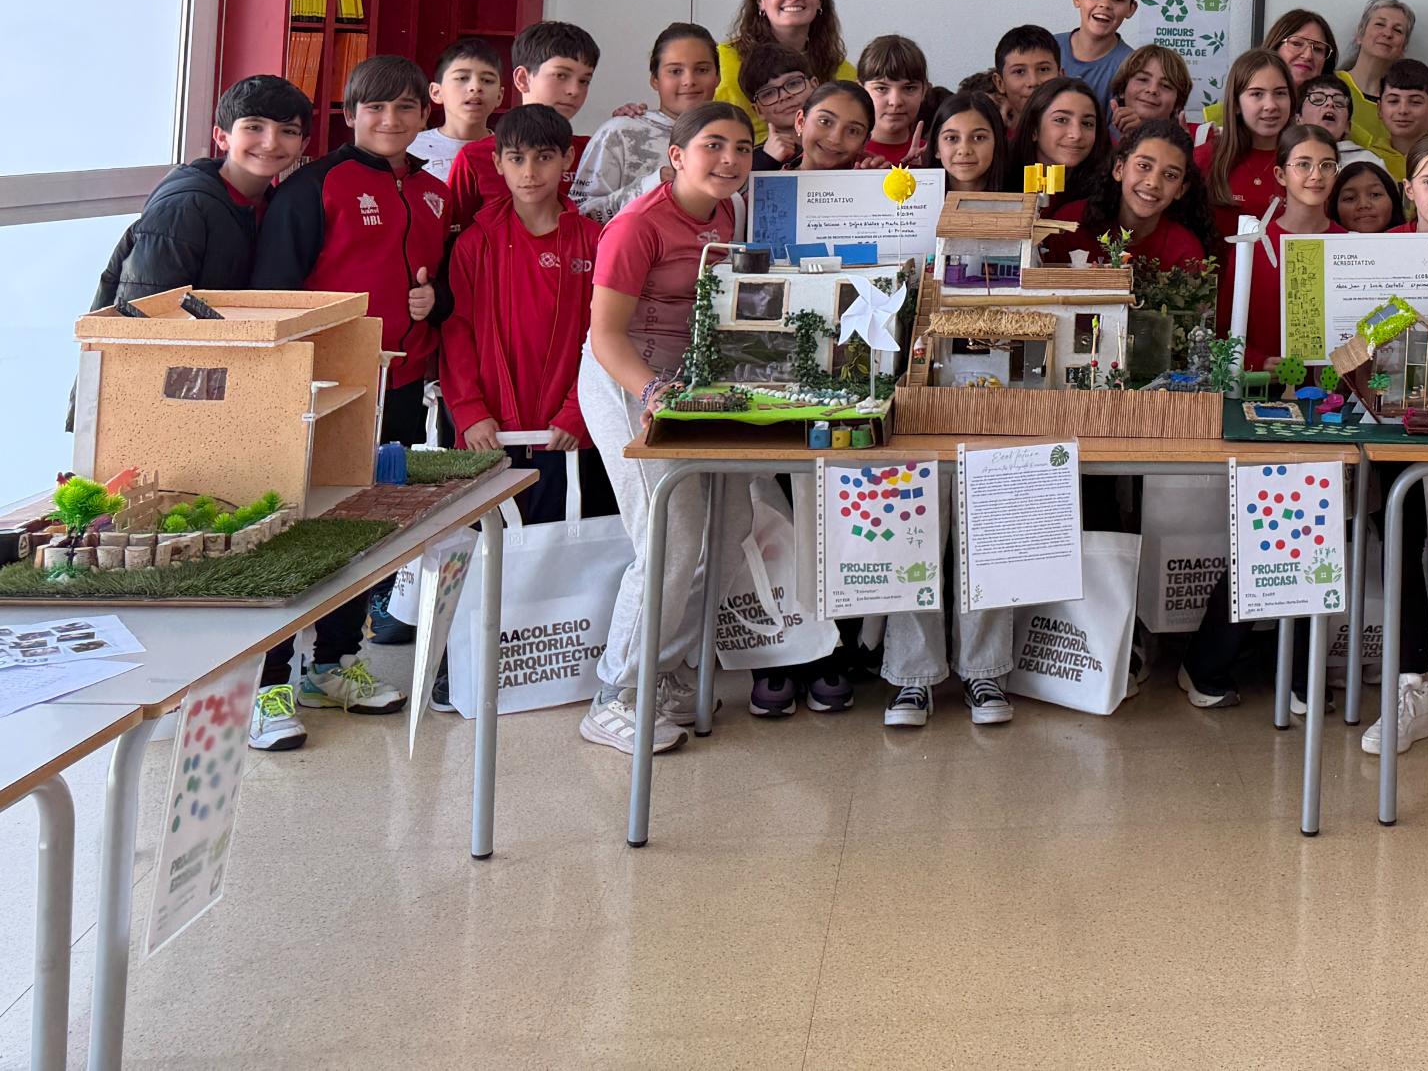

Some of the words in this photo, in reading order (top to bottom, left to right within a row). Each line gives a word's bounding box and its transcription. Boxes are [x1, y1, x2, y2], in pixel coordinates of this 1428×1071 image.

[1156, 27, 1194, 37] CONCURS
[1154, 38, 1196, 48] PROJECTE
[1195, 49, 1207, 57] 6E
[840, 562, 892, 573] PROJECTE
[1167, 557, 1228, 571] CTAACOL
[1251, 562, 1301, 574] PROJECTE
[844, 575, 889, 585] ECOCASA
[1166, 571, 1222, 585] TERRITO
[1255, 575, 1297, 587] ECOCASA
[500, 618, 591, 645] AACOLEGIO
[500, 634, 585, 659] RRITORIAL
[1018, 657, 1083, 682] DEALICANTE
